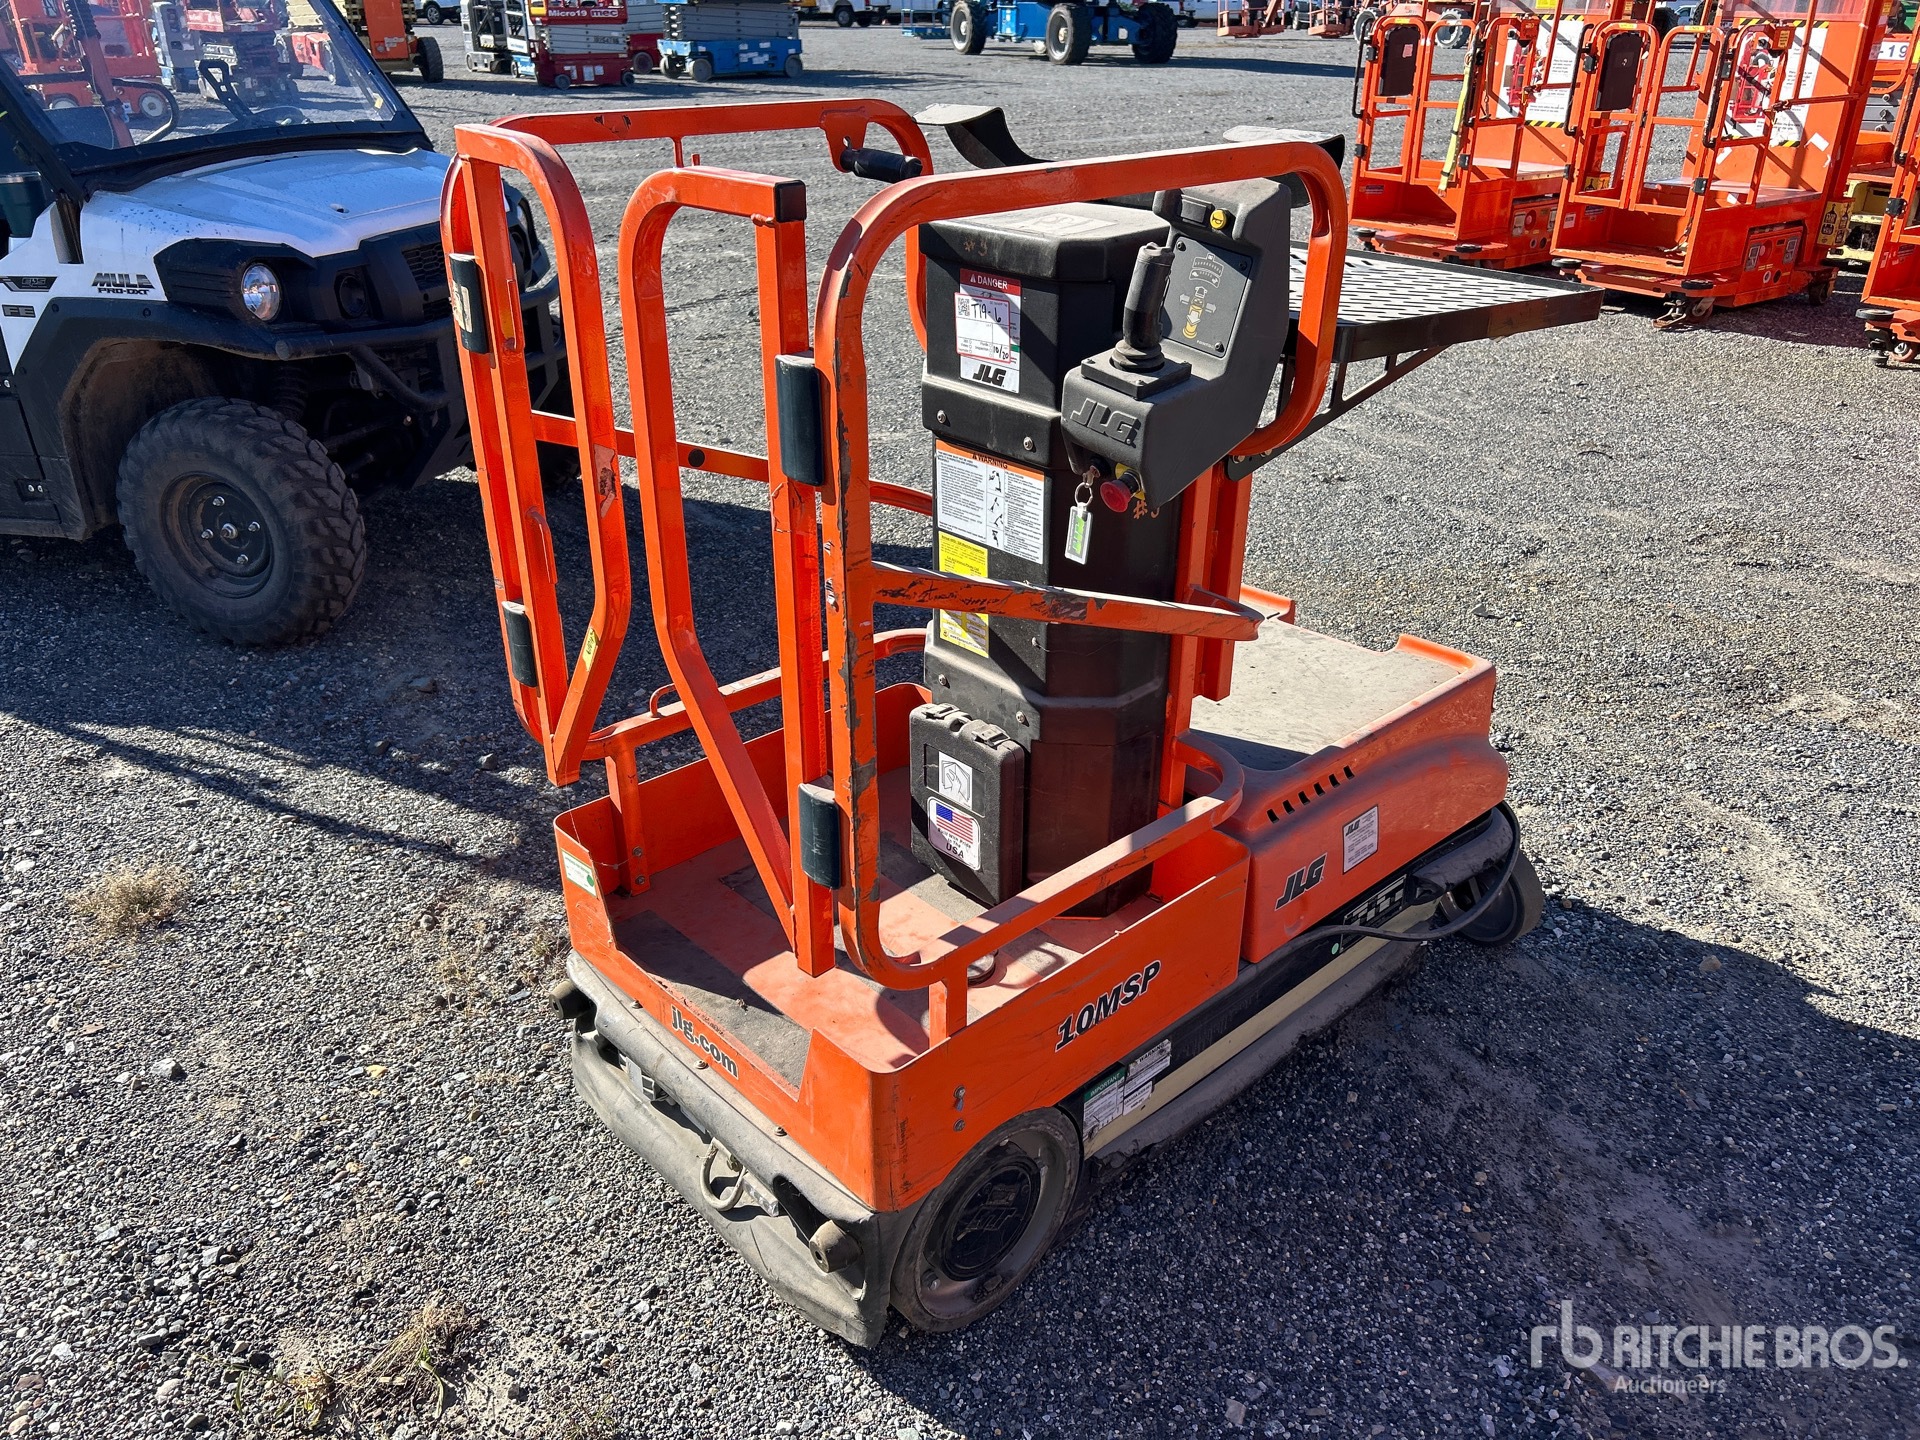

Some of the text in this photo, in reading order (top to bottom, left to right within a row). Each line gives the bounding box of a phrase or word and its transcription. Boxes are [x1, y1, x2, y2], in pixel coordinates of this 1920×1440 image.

[548, 9, 618, 18] Micro19 mec
[91, 272, 155, 289] MULE
[977, 275, 1008, 290] DANGER
[4, 306, 35, 316] FE
[972, 364, 1007, 387] JLG
[1069, 398, 1140, 445] JLG
[978, 454, 1008, 470] WARNING
[1345, 820, 1361, 837] JLG
[946, 842, 964, 859] USA
[1274, 852, 1327, 911] JLG
[1054, 959, 1161, 1053] 10MSP
[671, 1003, 739, 1080] jlg.com
[1089, 1072, 1121, 1098] IMPORTANT
